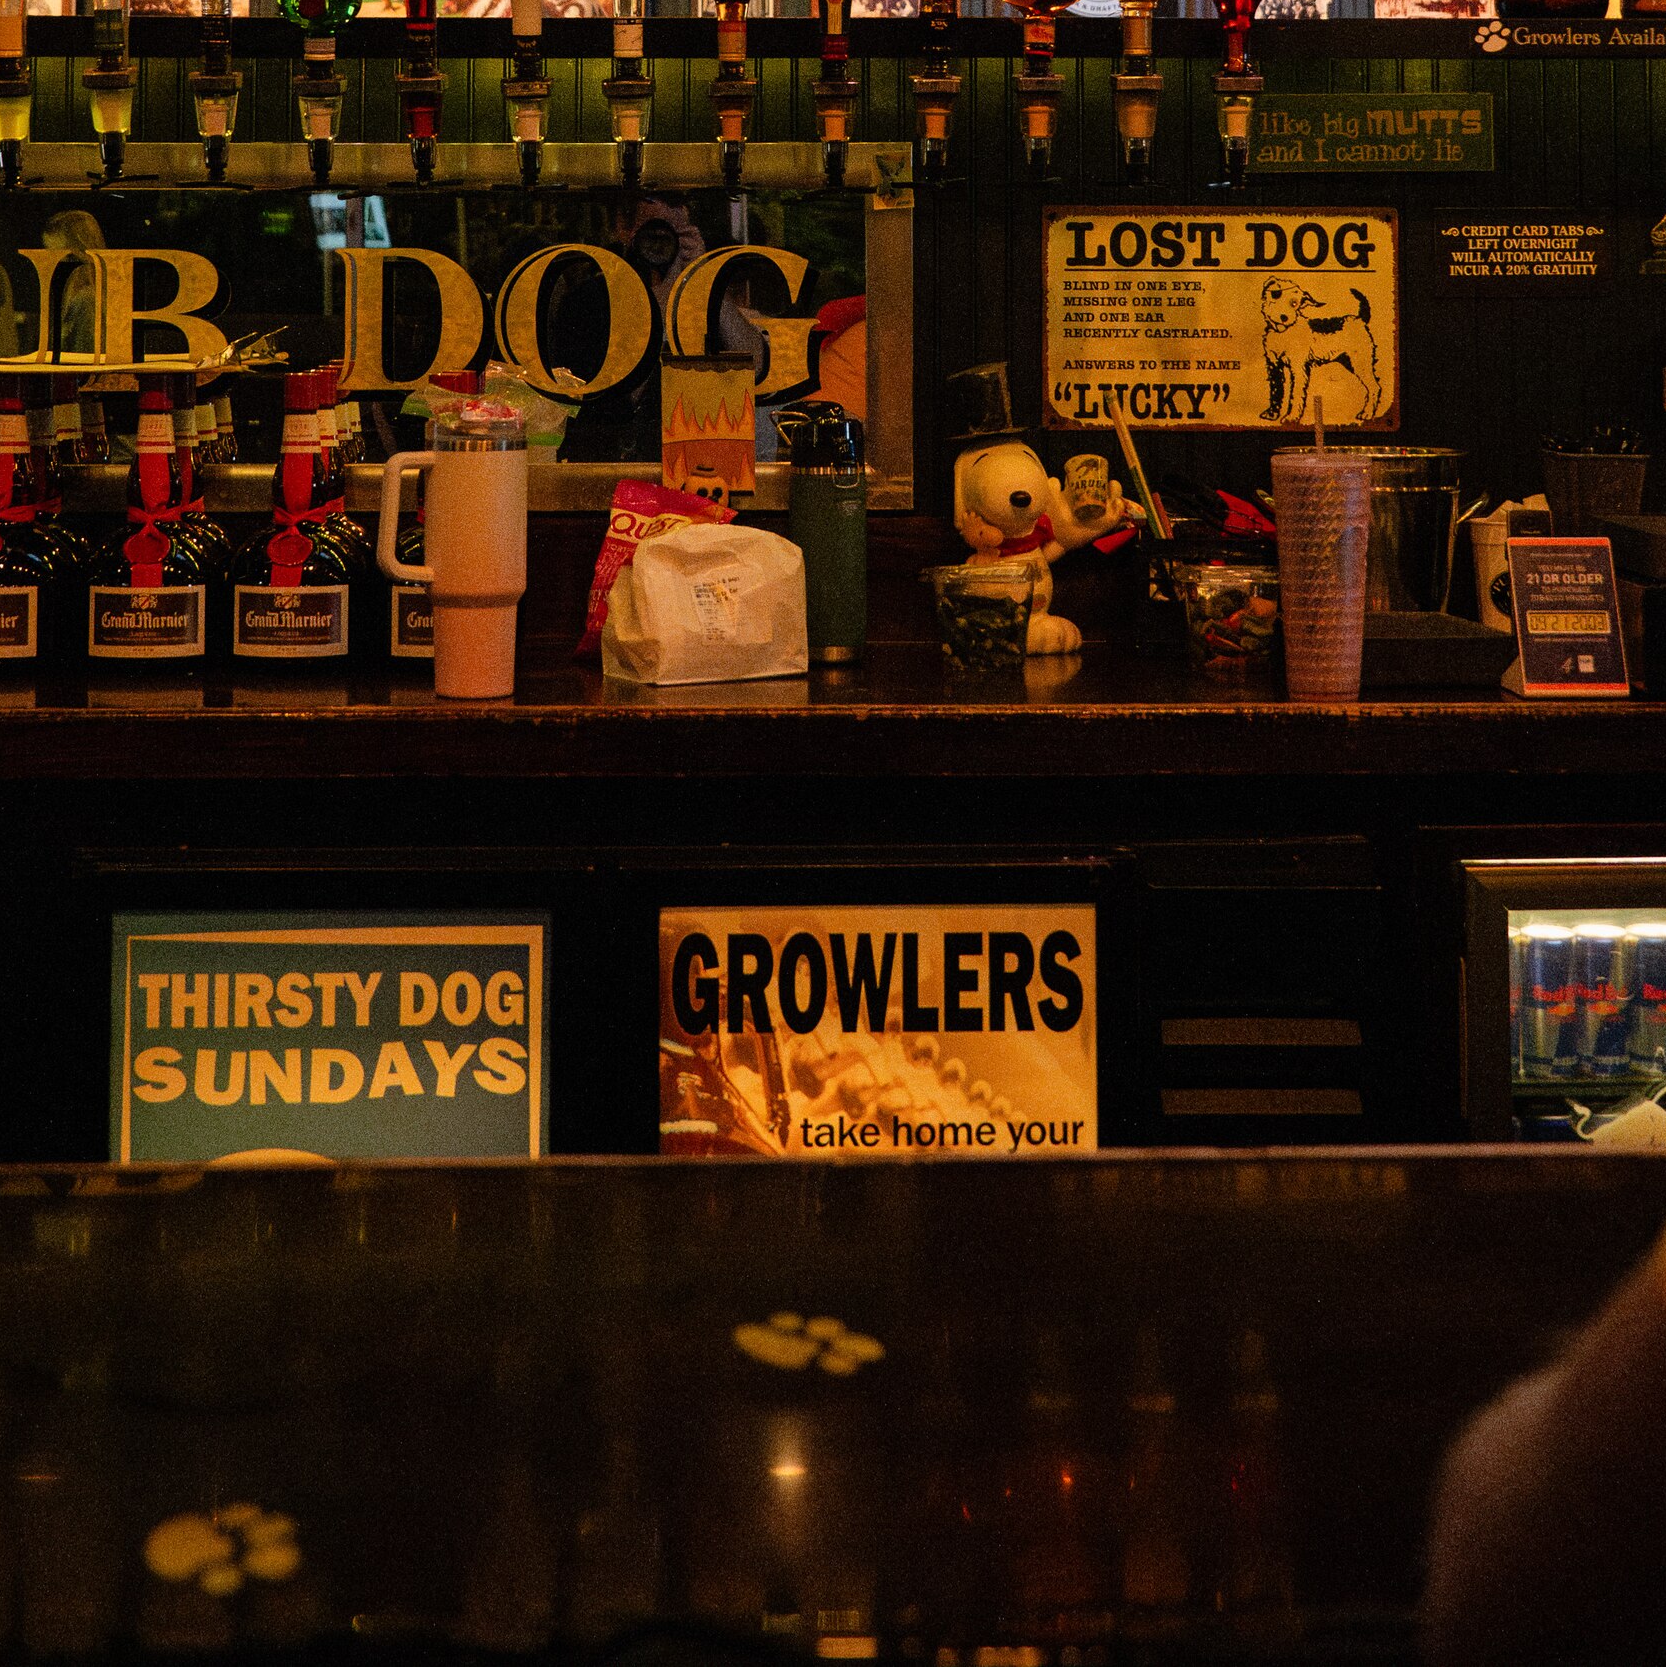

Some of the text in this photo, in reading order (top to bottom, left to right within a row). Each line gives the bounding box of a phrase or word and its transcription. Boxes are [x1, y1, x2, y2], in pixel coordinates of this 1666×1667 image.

[1512, 26, 1602, 47] Growlers
[1323, 112, 1360, 139] big
[1366, 110, 1482, 135] MUTTS
[1257, 138, 1464, 163] and I cannot lie
[1461, 225, 1585, 237] CREDIT CARD TABS
[1066, 222, 1376, 268] LOST DOG
[1468, 239, 1577, 249] LEFT OVERNIGHT
[1451, 251, 1595, 263] WILL AUTOMATICALLY
[1449, 265, 1598, 276] INCUR A 20% GRATUITY
[1063, 281, 1206, 294] BLIND IN ONE EYE,
[1063, 296, 1196, 307] MISSING ONE LEG
[336, 242, 830, 403] DOG
[1063, 312, 1165, 323] AND ONE EAR
[1063, 328, 1233, 339] RECENTLY CASTRATED.
[1063, 360, 1241, 370] ANSWERS TO THE NAME
[1526, 574, 1603, 584] 21 OR OLDER
[672, 930, 1084, 1035] GROWLERS
[138, 969, 525, 1030] THIRSTY DOG
[132, 1036, 529, 1107] SUNDAYS
[801, 1116, 1084, 1154] take home your
